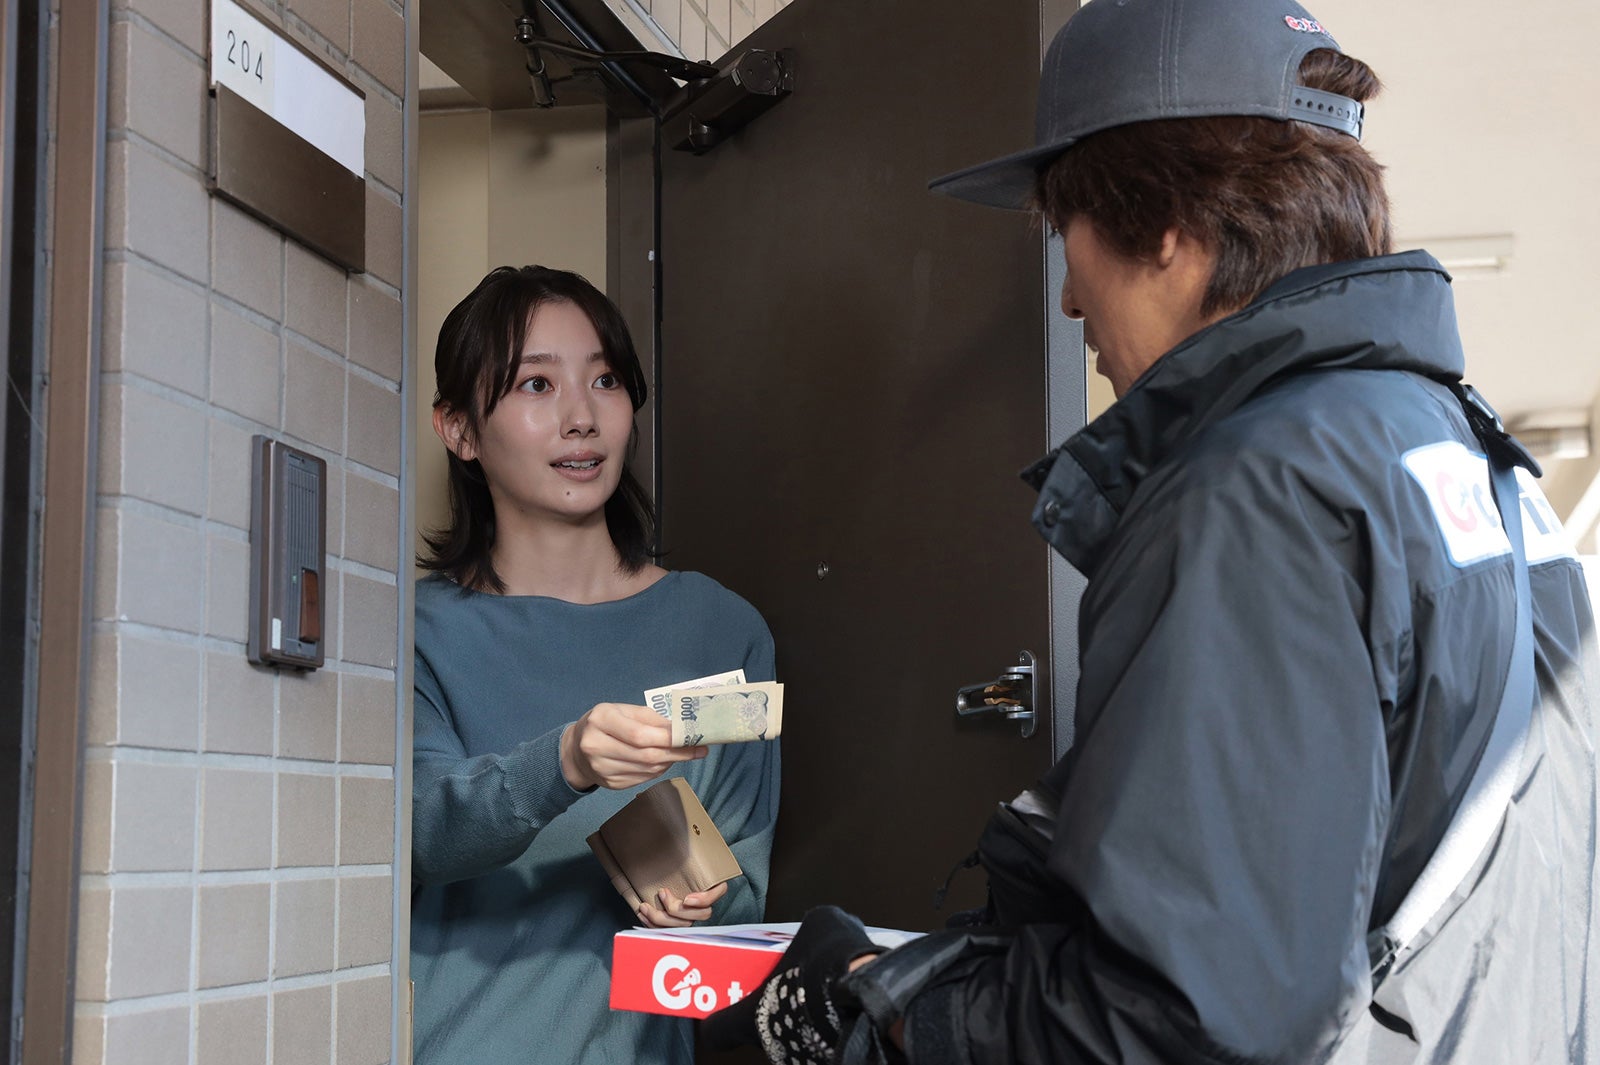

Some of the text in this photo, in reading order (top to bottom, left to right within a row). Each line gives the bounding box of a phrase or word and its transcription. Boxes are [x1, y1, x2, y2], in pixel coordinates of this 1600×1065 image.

[227, 29, 263, 84] 204
[680, 696, 693, 721] 1000
[652, 954, 717, 1012] Go
